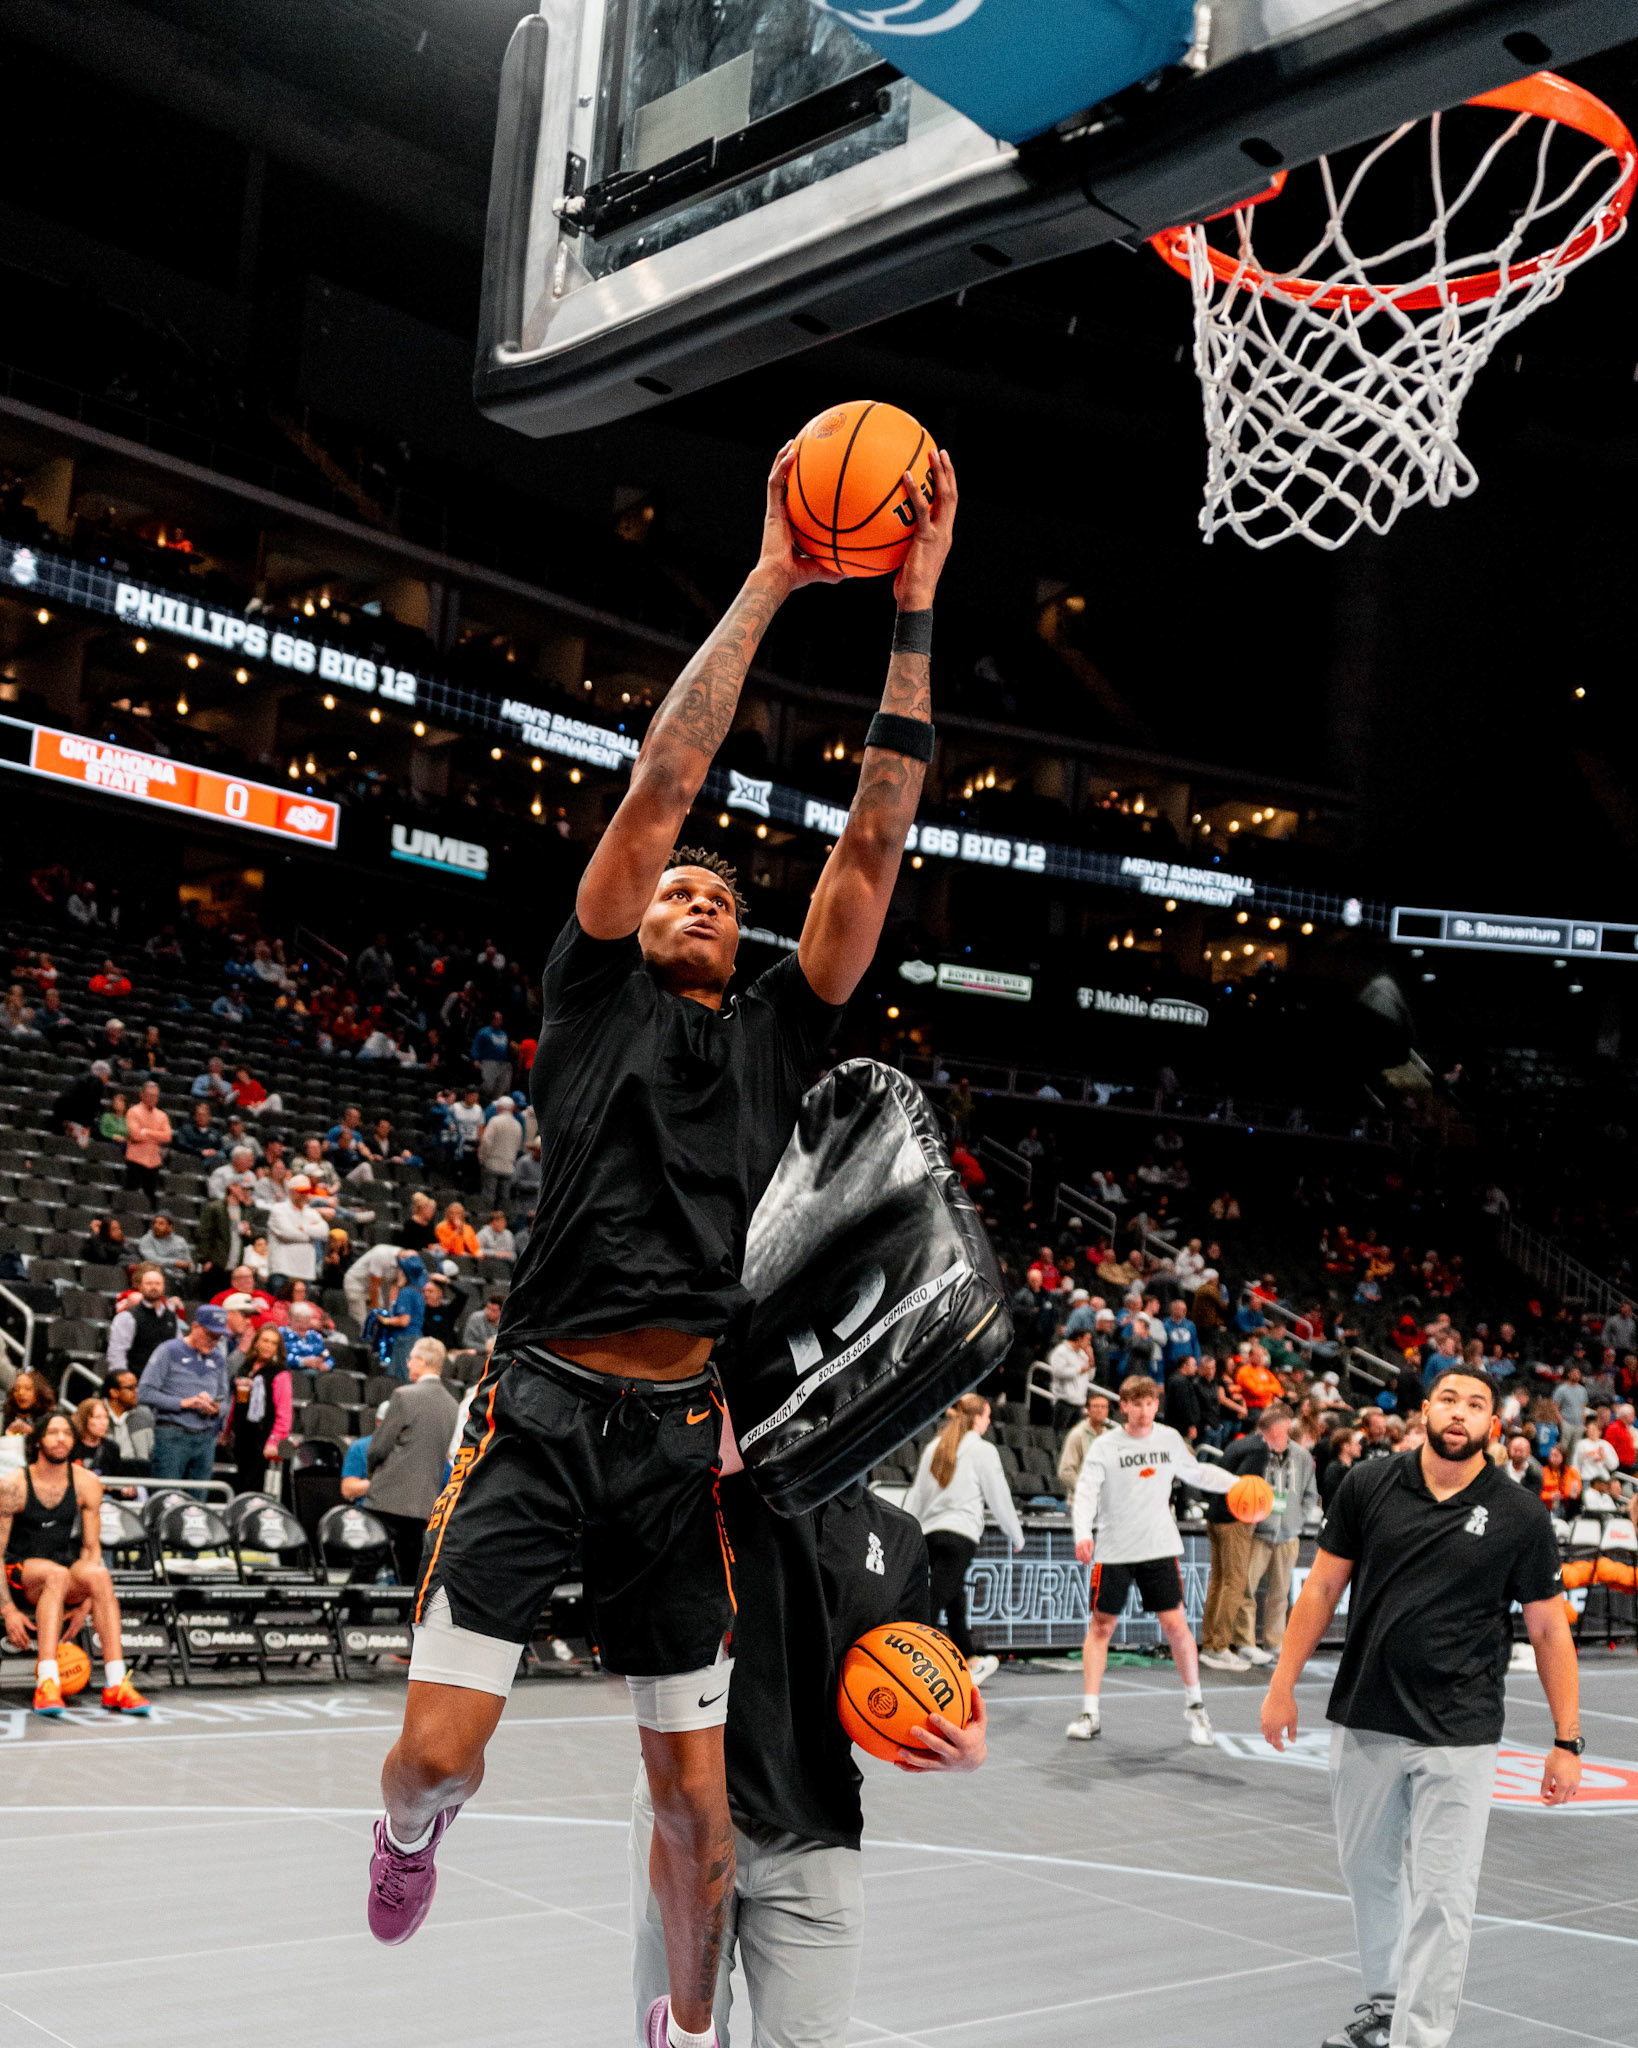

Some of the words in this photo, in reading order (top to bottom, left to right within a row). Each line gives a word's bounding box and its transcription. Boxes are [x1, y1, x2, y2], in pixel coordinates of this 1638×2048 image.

[115, 582, 268, 658] PHILLIPS
[271, 632, 316, 673] 66
[319, 647, 377, 692] BIG
[379, 665, 417, 705] 12
[501, 698, 551, 729] MEN'S
[552, 714, 640, 759] BASKETBALL
[522, 722, 623, 770] TOURNAMENT
[59, 737, 176, 785] OKLAHOMA
[85, 762, 148, 795] STATE
[225, 783, 249, 818] 0
[391, 824, 489, 872] UMB
[920, 826, 959, 857] 66
[961, 832, 1011, 867] BIG
[1012, 842, 1046, 873] 12
[1121, 856, 1169, 878] MEN'S
[1169, 864, 1254, 896] BASKETBALL
[1140, 875, 1237, 908] TOURNAMENT
[1475, 921, 1560, 944] Bonaventure
[1094, 990, 1148, 1017] Mobile
[1150, 1002, 1203, 1025] CENTER
[747, 1401, 793, 1444] SALISBURY,
[796, 1385, 806, 1404] NC
[818, 1333, 871, 1382] 800-438-6018
[883, 1287, 931, 1327] CAMARGO,
[936, 1279, 944, 1291] IL
[1119, 1453, 1147, 1468] LOCK
[1150, 1451, 1159, 1464] IT
[426, 1446, 476, 1532] POKES
[884, 1634, 955, 1712] Wilson
